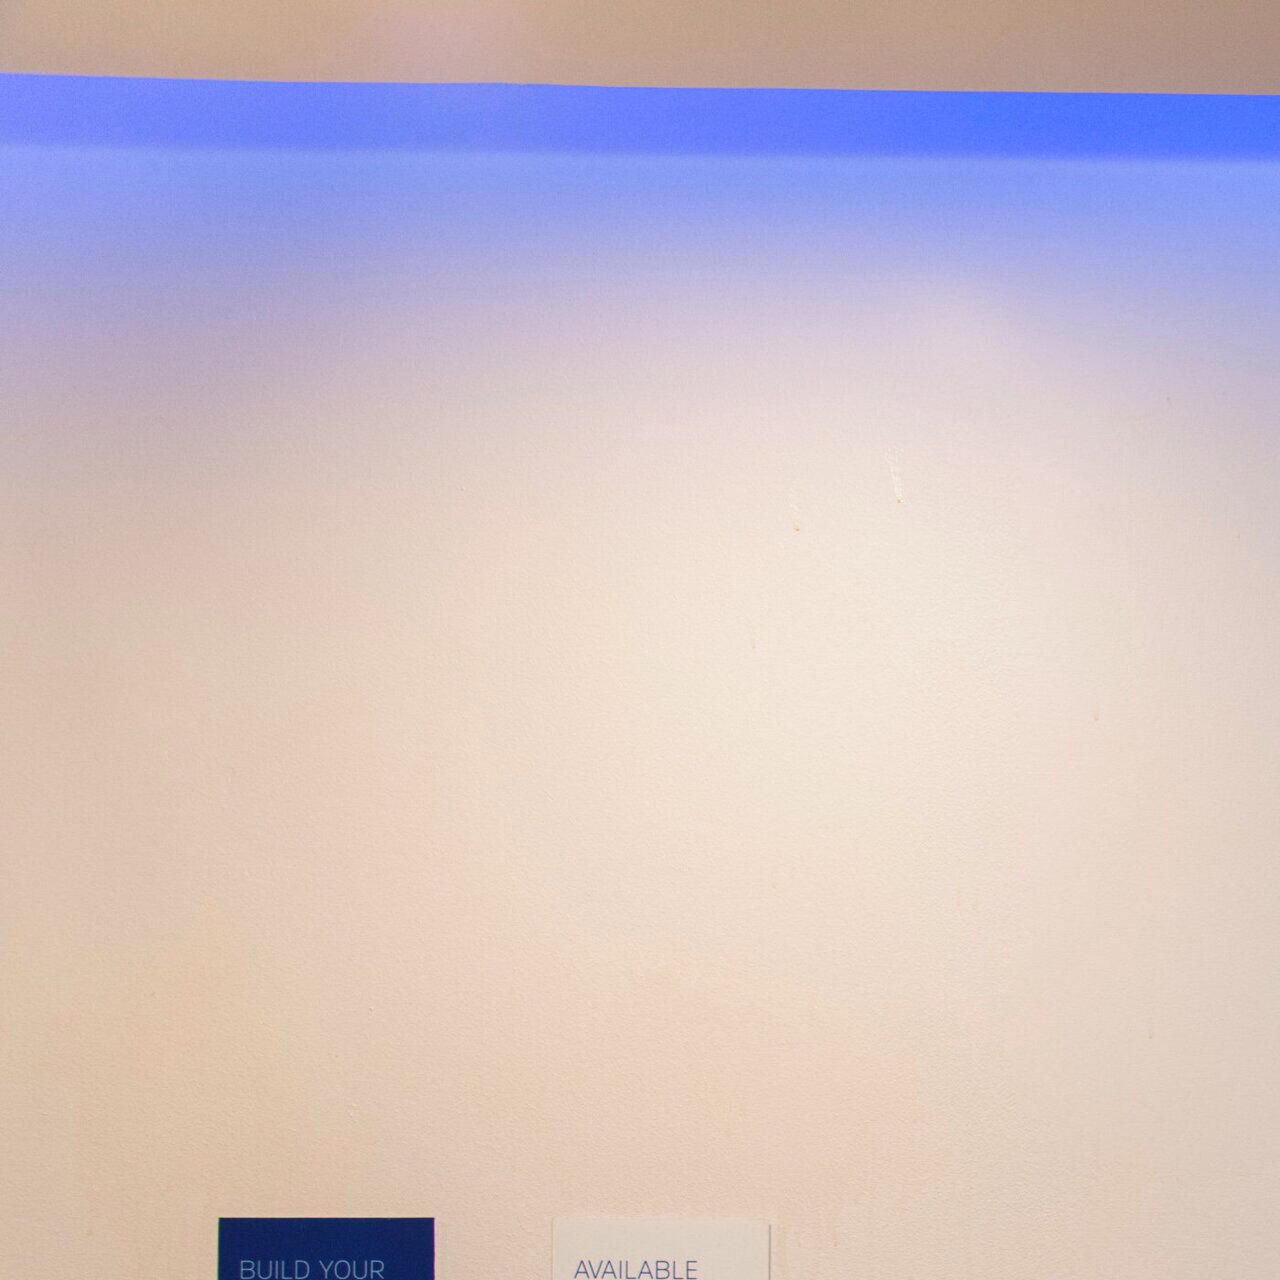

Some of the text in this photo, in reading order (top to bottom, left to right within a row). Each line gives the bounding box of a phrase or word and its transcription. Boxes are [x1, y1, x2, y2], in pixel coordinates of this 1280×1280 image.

[240, 1260, 385, 1280] BUILD YOUR
[574, 1260, 698, 1280] AVAILABLE
